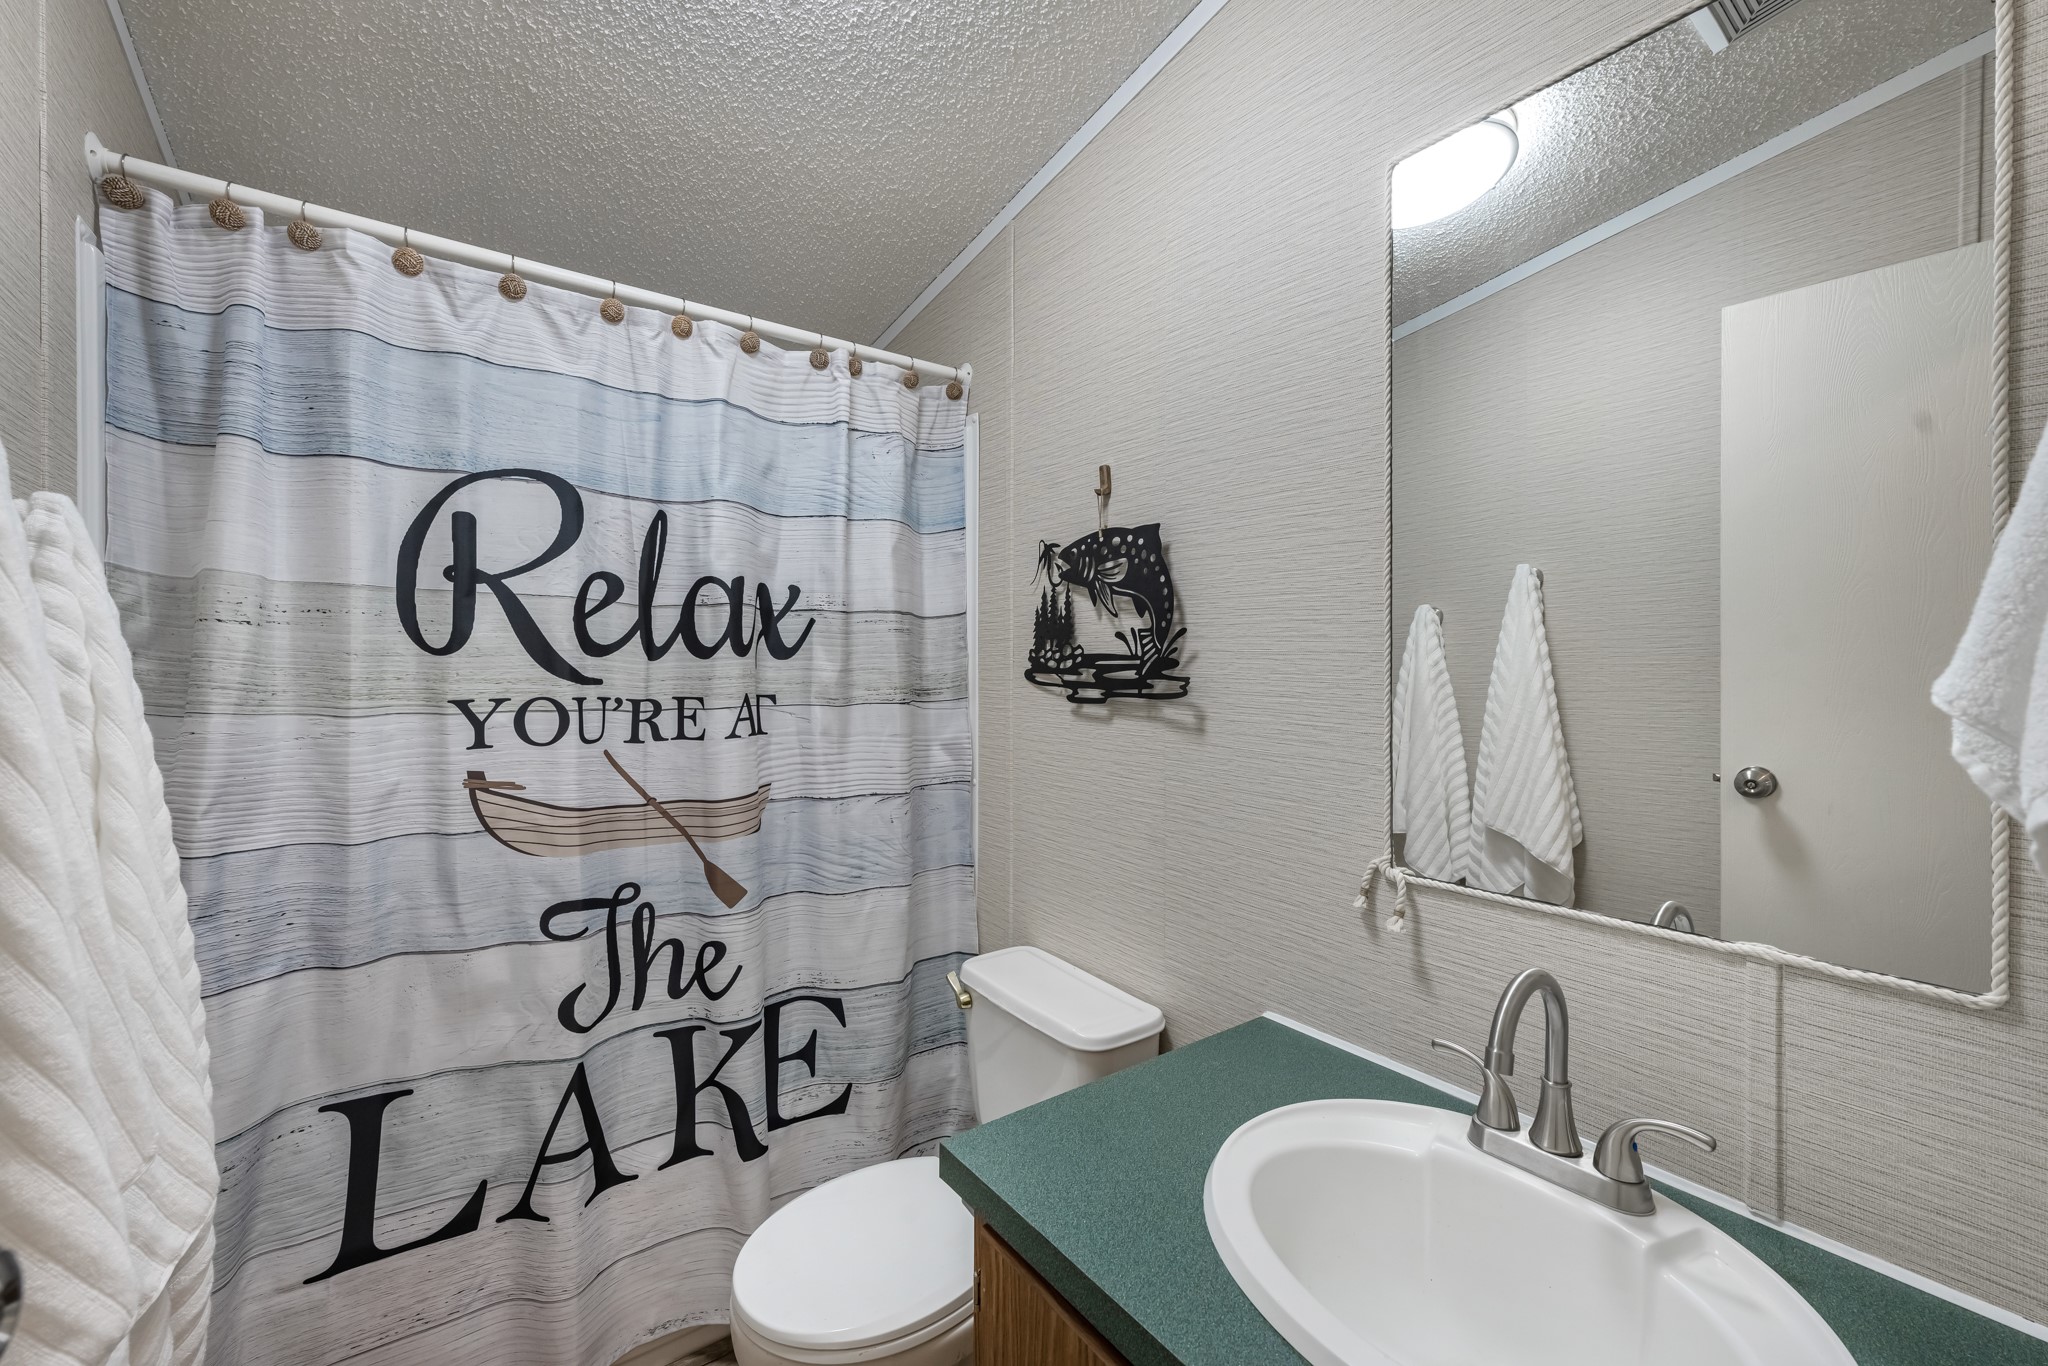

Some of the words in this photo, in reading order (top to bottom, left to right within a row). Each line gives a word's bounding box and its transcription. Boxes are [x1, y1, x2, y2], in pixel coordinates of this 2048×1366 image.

[396, 468, 816, 686] Relax
[446, 693, 706, 751] YOU'RE
[539, 881, 743, 1034] The
[302, 996, 853, 1286] LAKE
